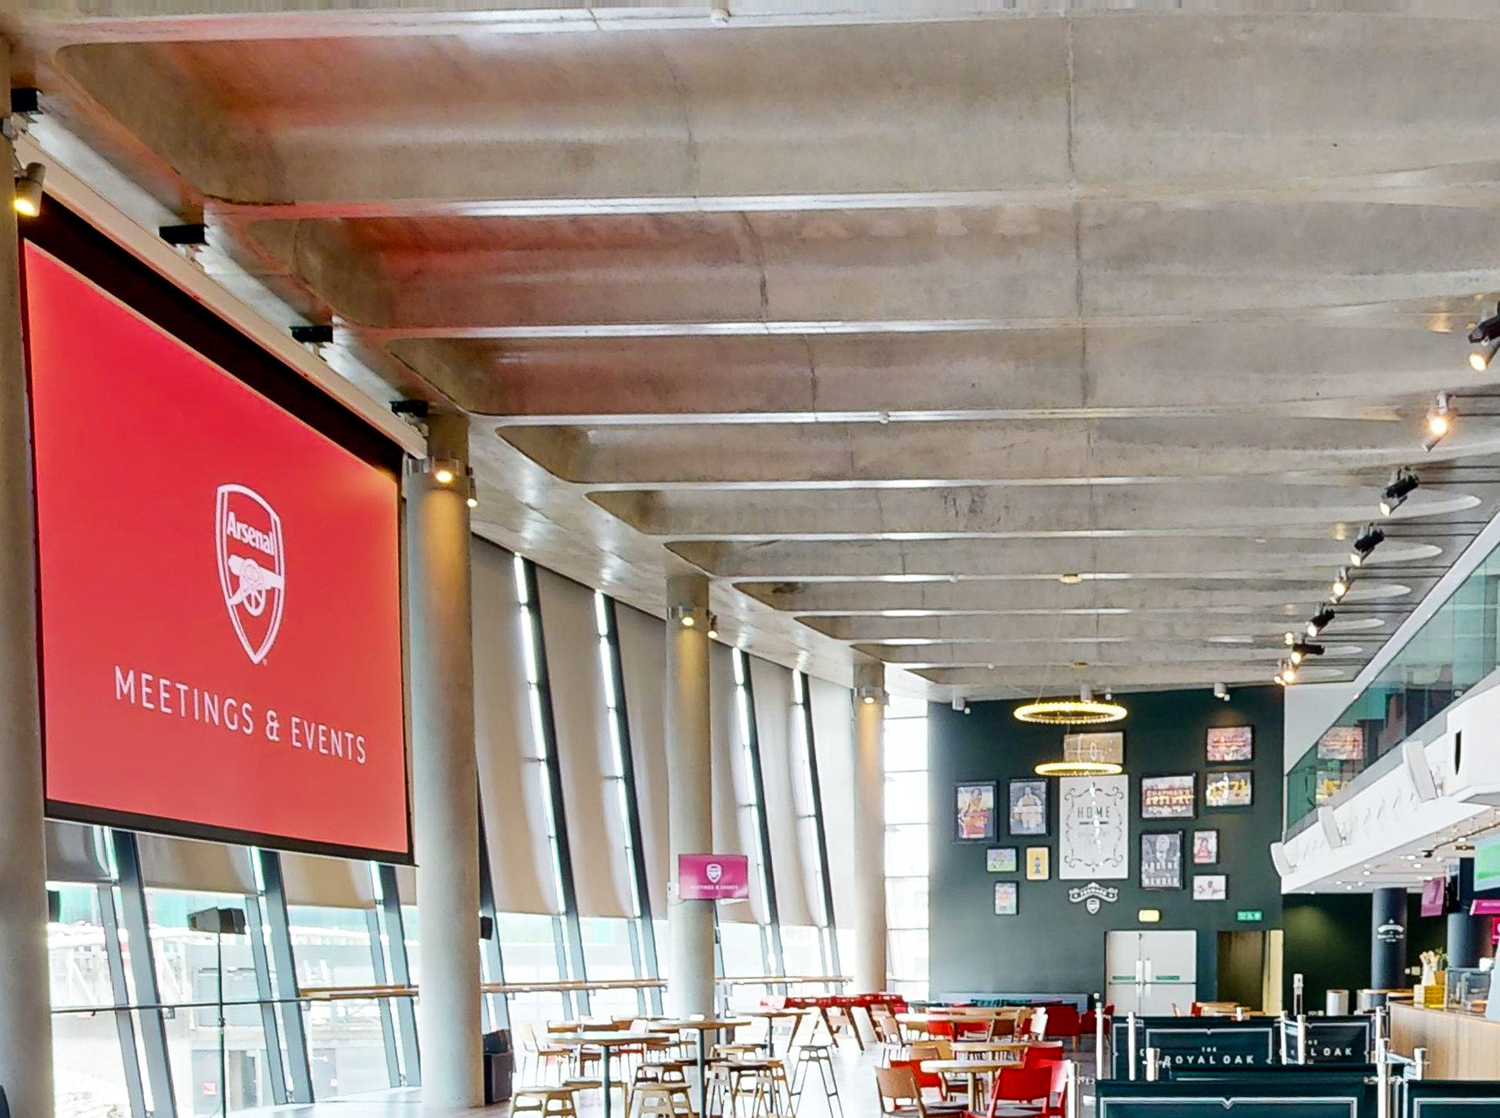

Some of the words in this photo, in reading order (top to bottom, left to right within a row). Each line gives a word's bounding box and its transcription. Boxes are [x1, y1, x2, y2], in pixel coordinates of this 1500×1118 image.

[227, 511, 275, 555] Arsenal
[115, 665, 254, 735] MEETINGS
[265, 710, 280, 742] &
[291, 716, 366, 764] EVENTS
[1164, 1055, 1216, 1065] ROYAL
[1222, 1055, 1254, 1065] OAK
[1323, 1047, 1352, 1056] OAK
